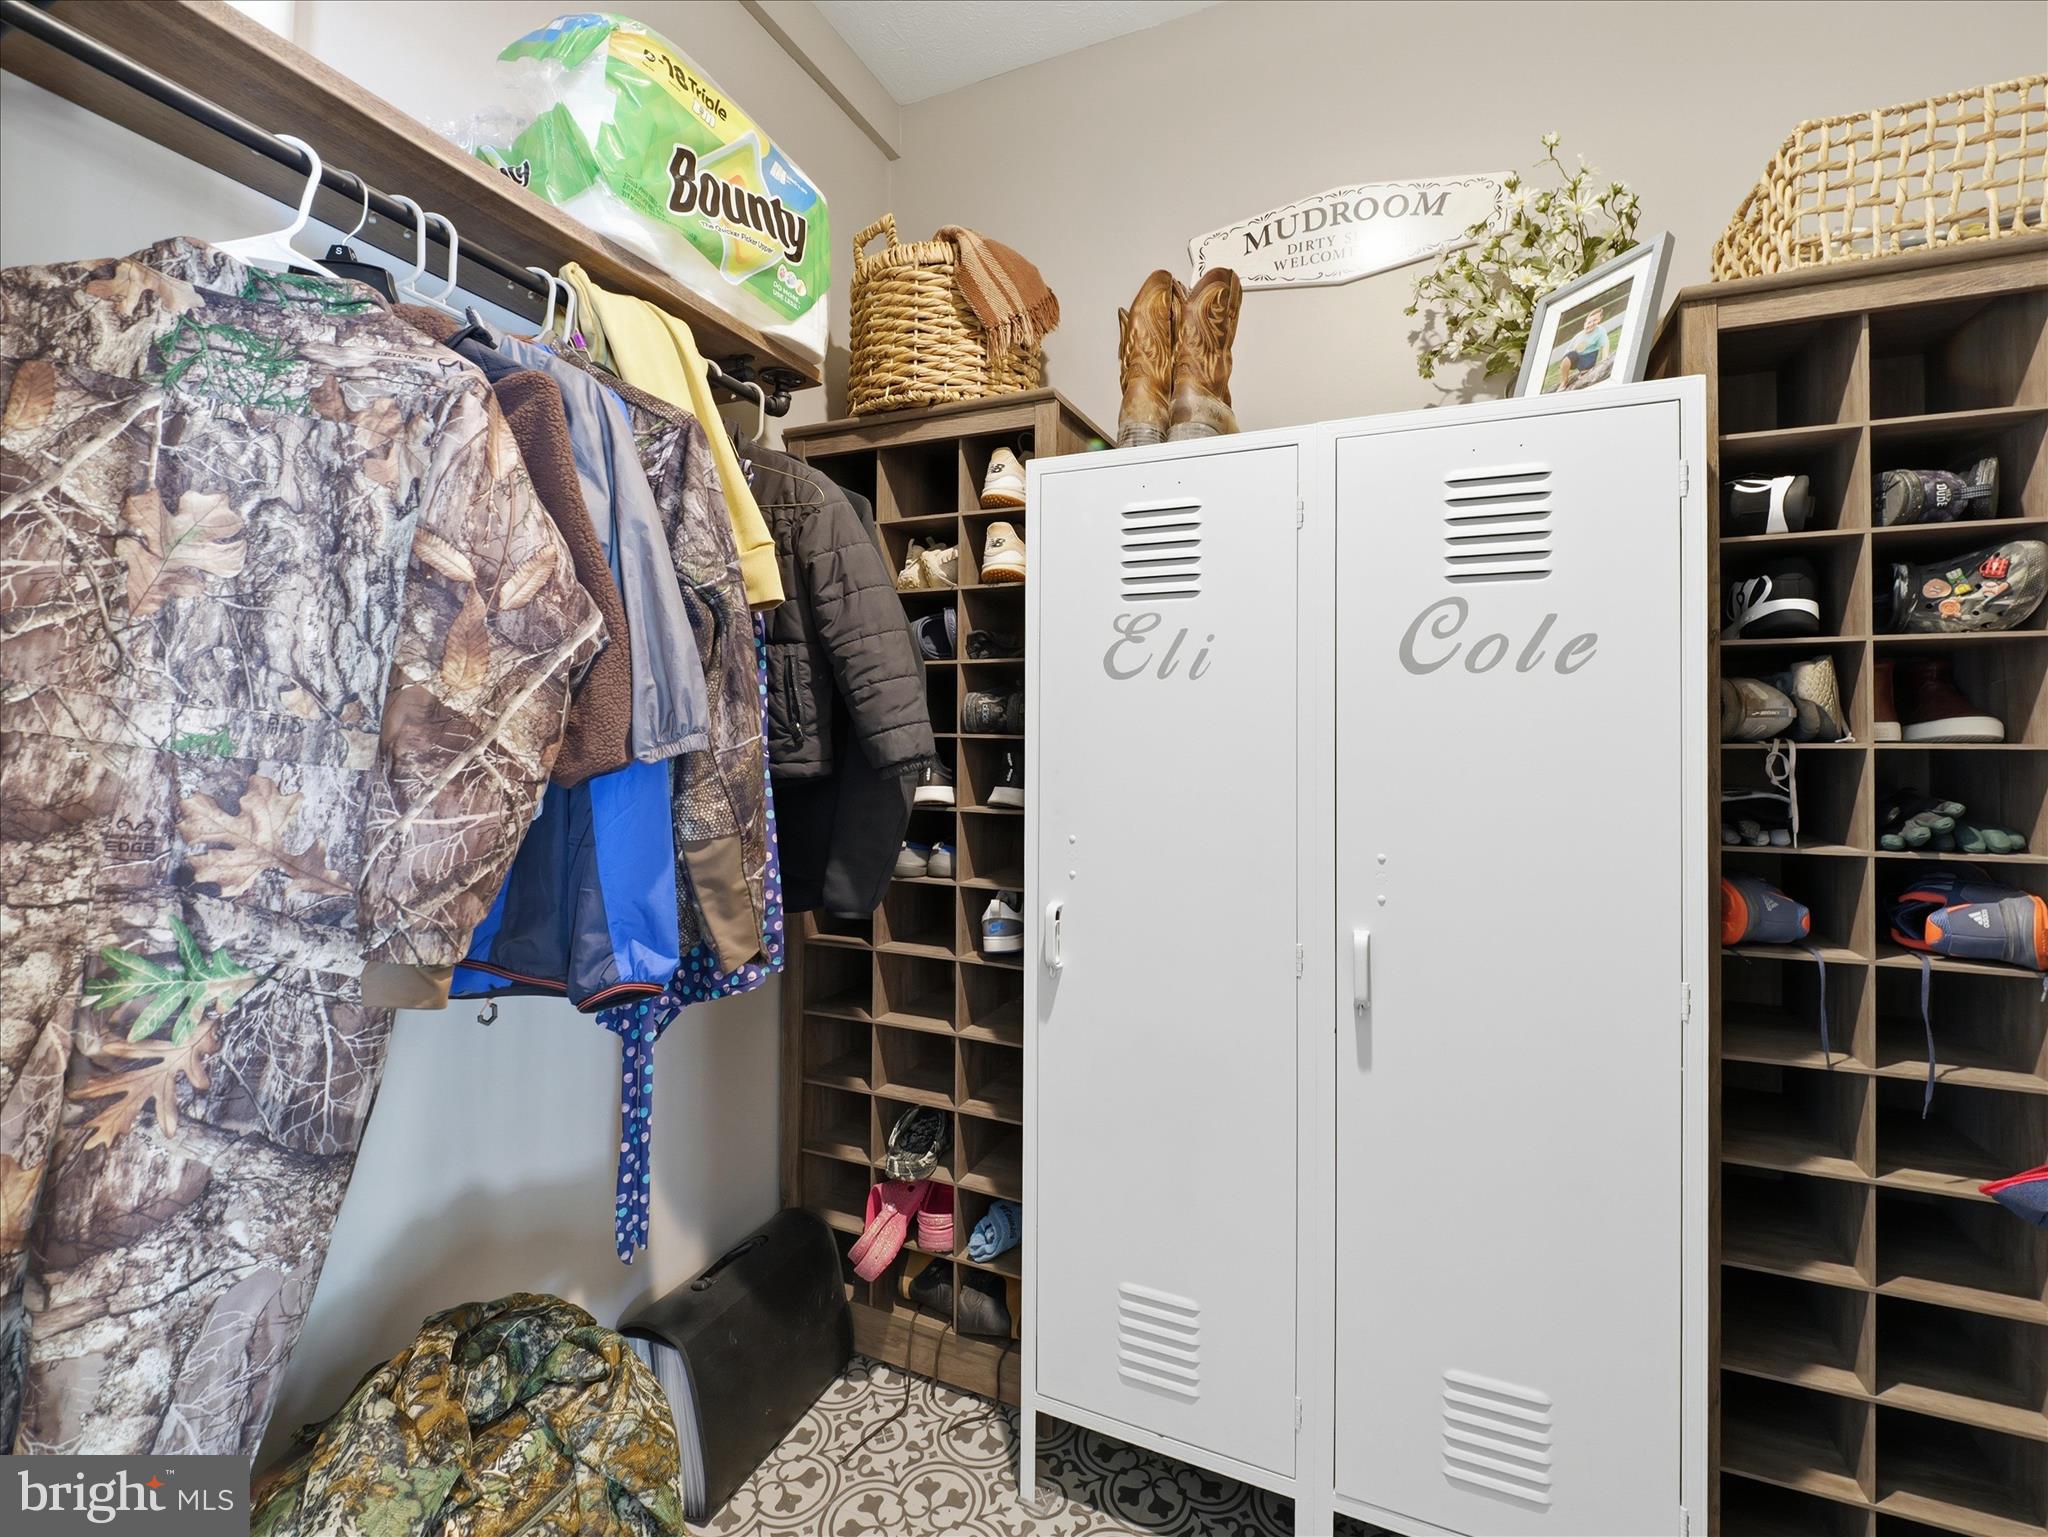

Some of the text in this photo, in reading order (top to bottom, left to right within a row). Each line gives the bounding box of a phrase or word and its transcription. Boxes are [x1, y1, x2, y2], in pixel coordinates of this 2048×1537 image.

[688, 76, 727, 121] Triple
[668, 146, 807, 263] Bounty
[1243, 191, 1452, 256] MUDROOM
[335, 246, 343, 255] S
[1287, 235, 1336, 255] DIRTY
[1936, 483, 1949, 507] DUDE
[1102, 612, 1215, 680] Eli
[1398, 596, 1598, 675] Cole
[104, 841, 156, 852] EDGE
